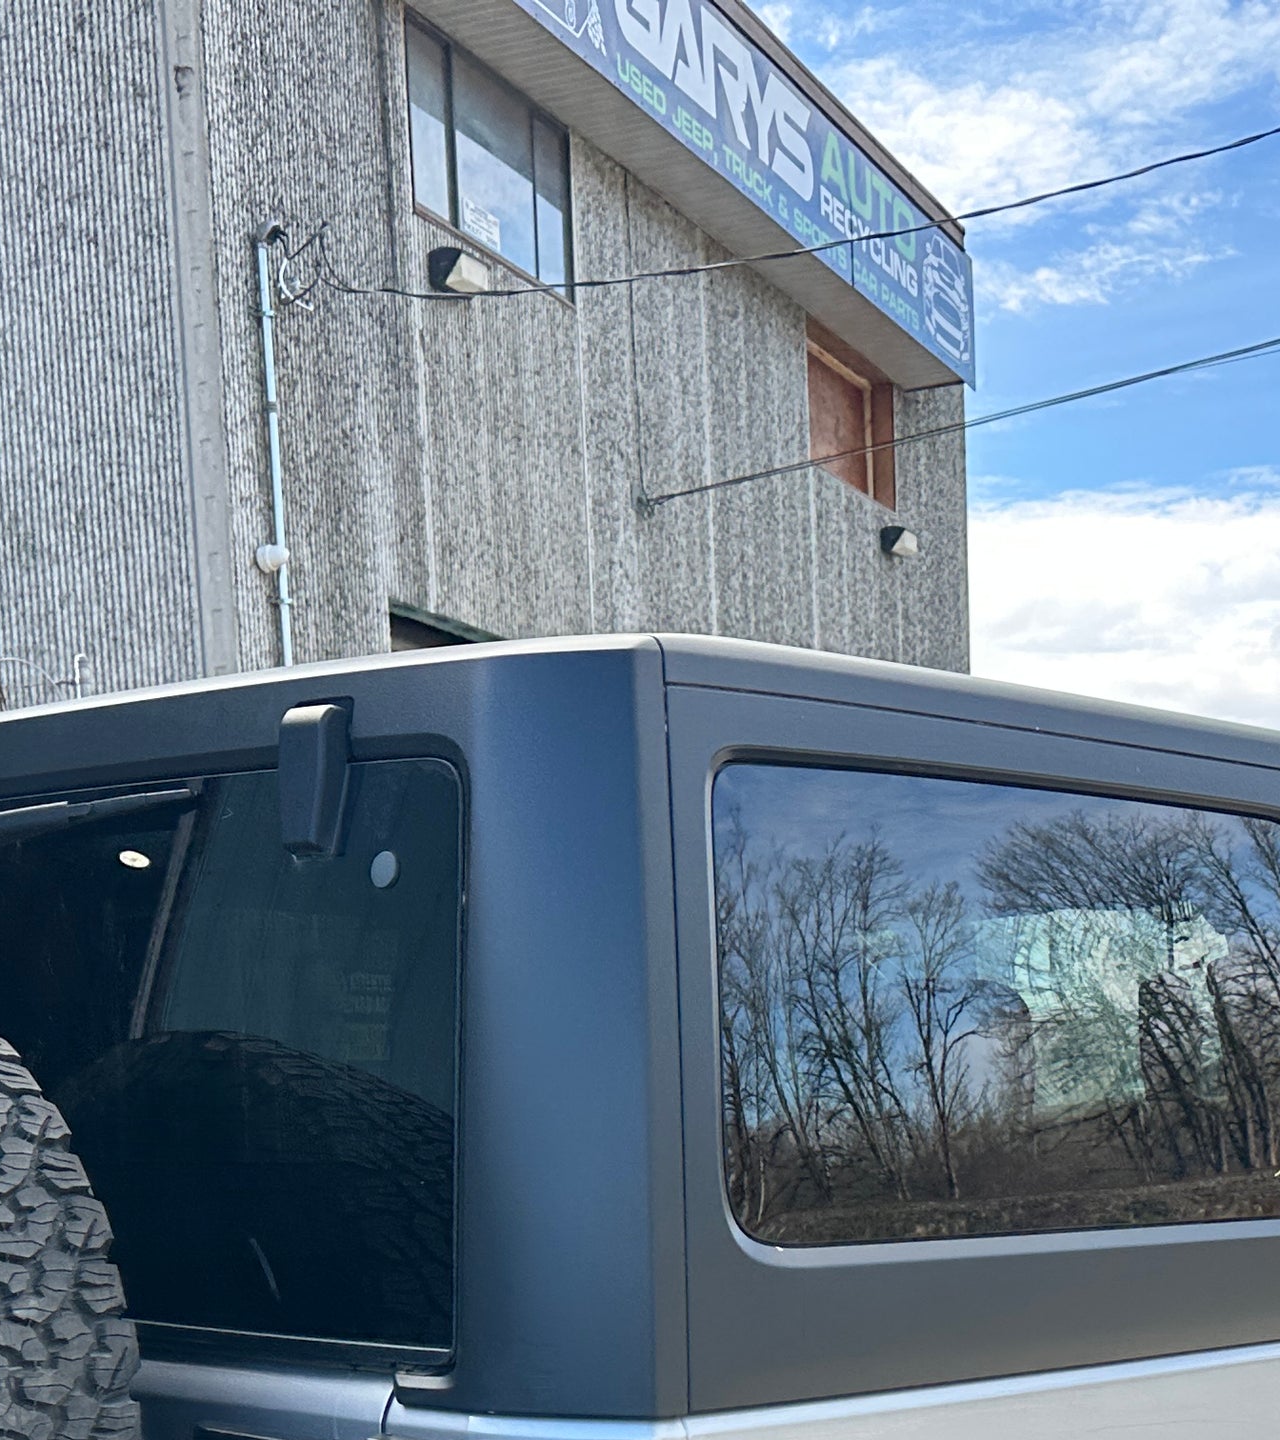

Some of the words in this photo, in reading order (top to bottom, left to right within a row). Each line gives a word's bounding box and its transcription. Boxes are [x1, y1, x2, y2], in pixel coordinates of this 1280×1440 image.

[616, 52, 667, 116] USED
[722, 143, 774, 208] TRUCK
[778, 192, 790, 220] &
[853, 257, 879, 299] CAR
[881, 286, 920, 332] PARTS
[820, 184, 919, 299] RECYCLING
[821, 131, 917, 263] AUTO
